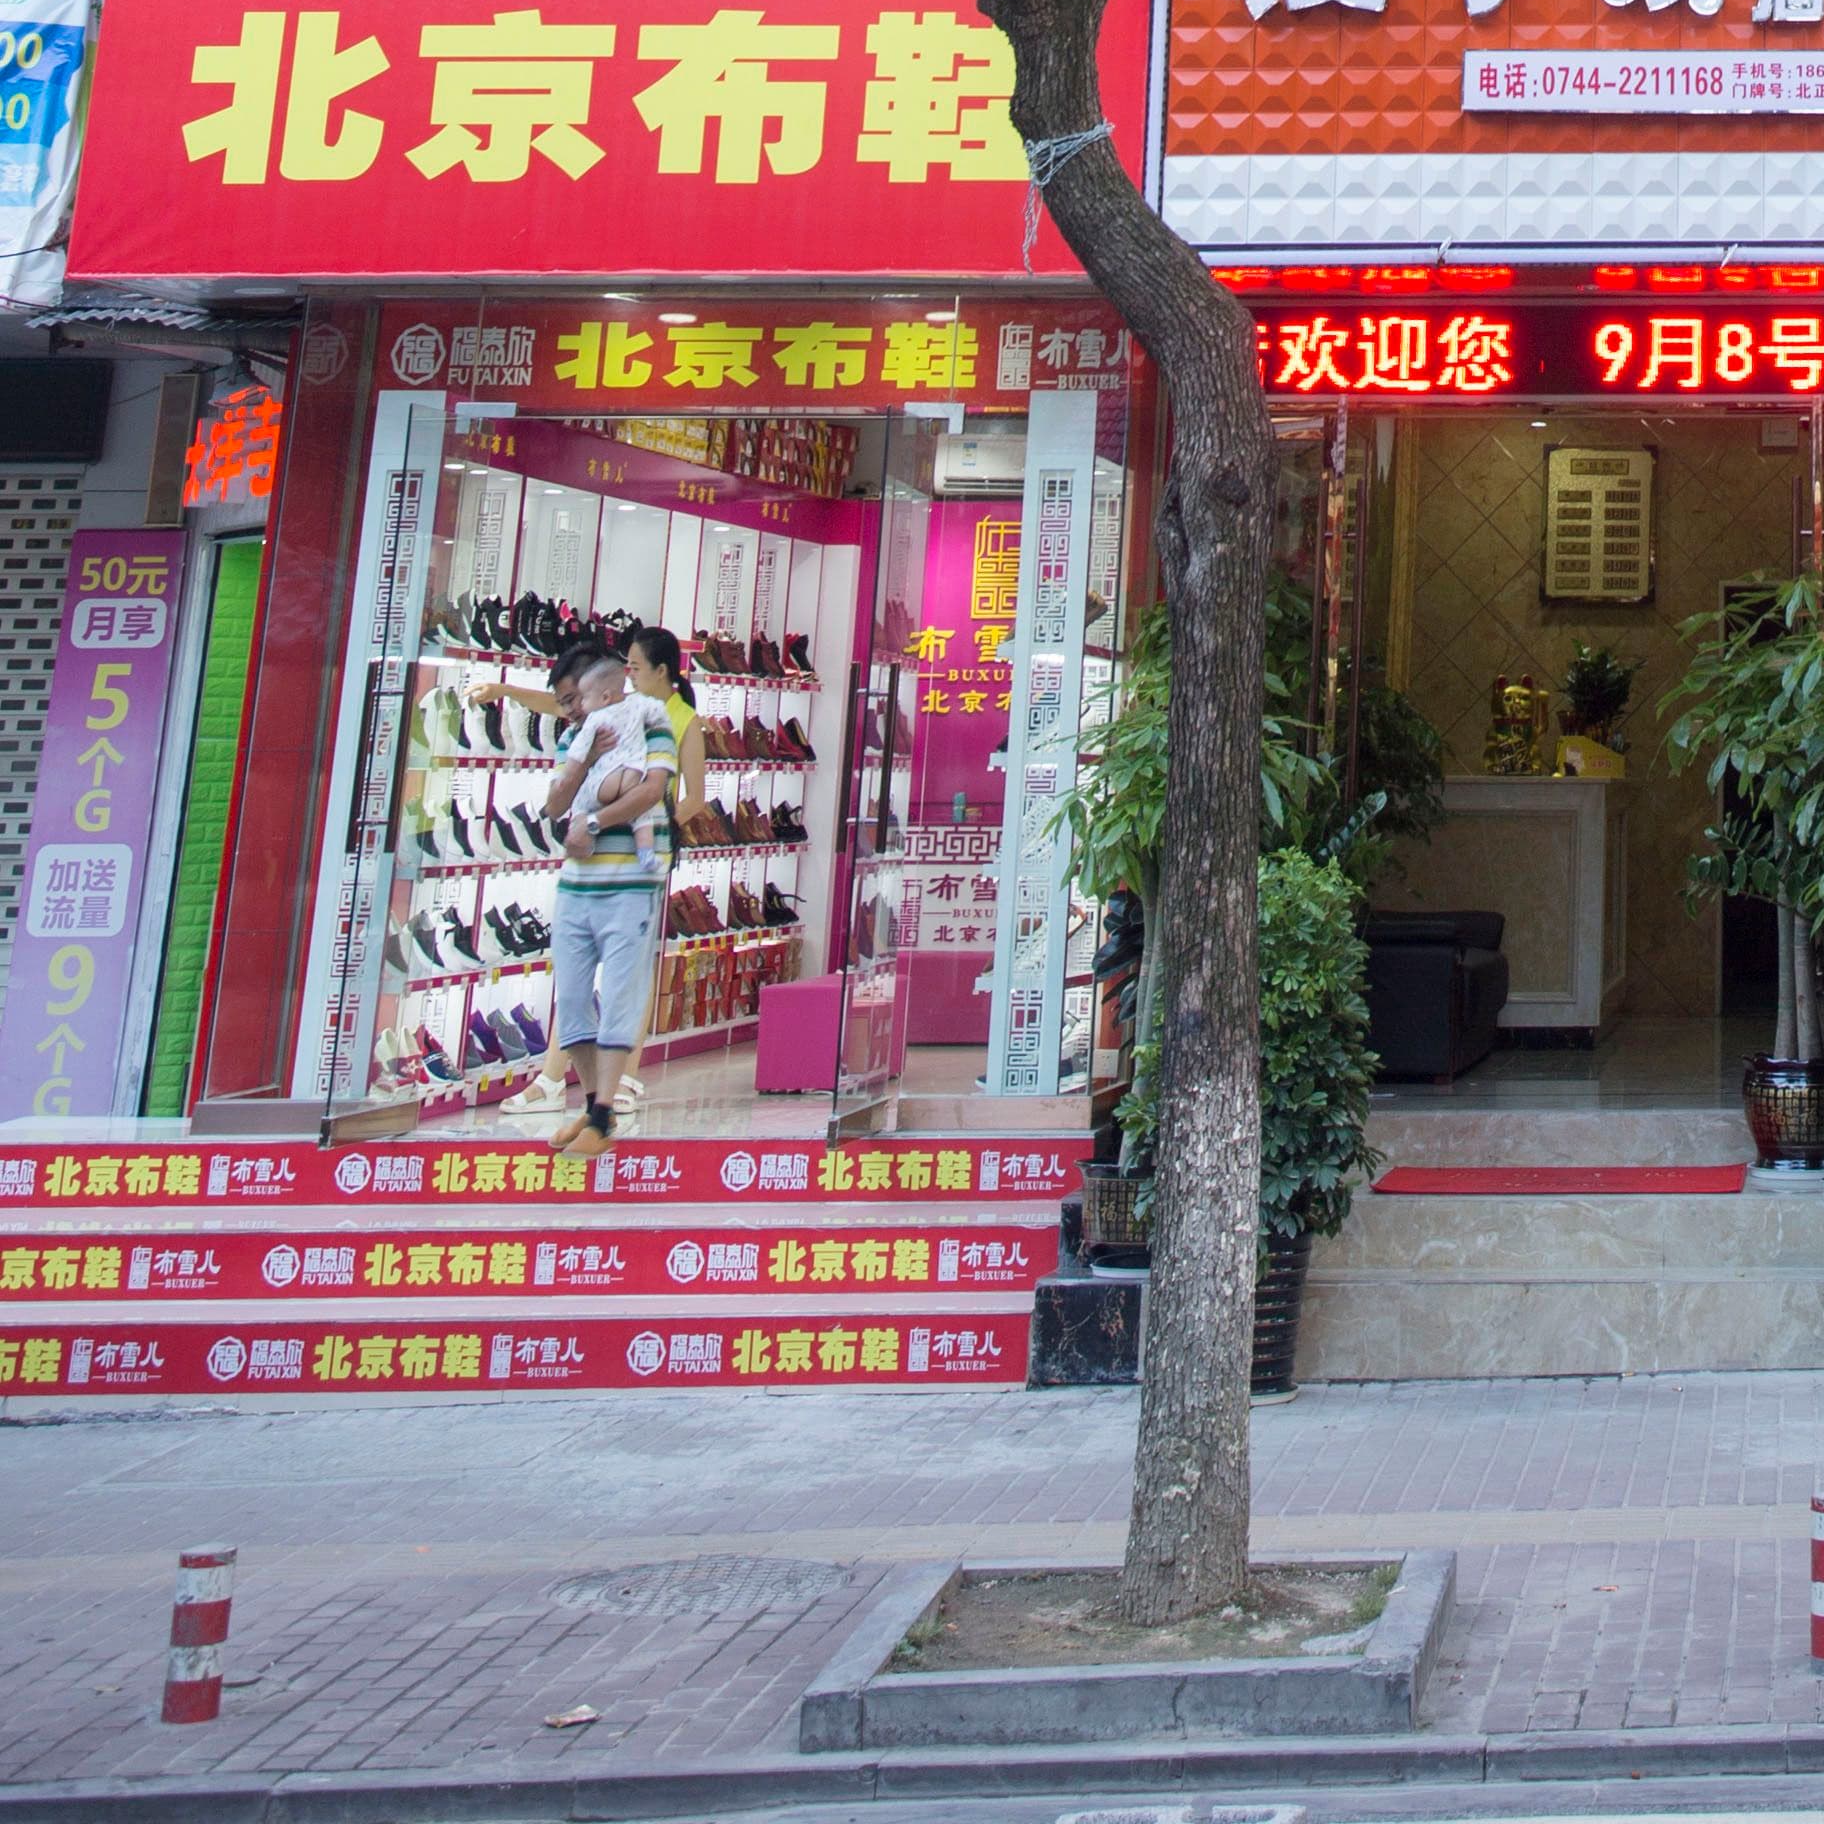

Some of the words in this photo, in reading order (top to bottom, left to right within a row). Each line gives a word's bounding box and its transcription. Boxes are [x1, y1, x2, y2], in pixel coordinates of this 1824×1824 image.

[181, 7, 1032, 186] 北京布鞋
[450, 327, 536, 367] 福泰欣
[554, 320, 979, 390] 北京布鞋
[1257, 315, 1512, 391] 欢迎您
[1057, 374, 1121, 390] BUXUER
[79, 555, 169, 596] 50元
[82, 605, 157, 641] 月享
[946, 668, 1013, 683] BUXU
[46, 857, 117, 893] 加送
[40, 895, 113, 930] 流量
[951, 908, 998, 919] BUXU
[0, 1159, 37, 1184] 泰欣
[44, 1155, 202, 1196] 北京布鞋
[232, 1155, 296, 1183] 布雪儿
[374, 1154, 425, 1180] 福泰欣
[618, 1155, 682, 1181] 布雪儿
[759, 1153, 809, 1178] 福泰欣
[817, 1149, 972, 1192] 北京布鞋
[1001, 1153, 1066, 1180] 布雪儿
[242, 1184, 281, 1195] BUXUER
[628, 1183, 667, 1193] BUXUER
[1013, 1180, 1053, 1192] BUXUER
[0, 1246, 122, 1290] 京布鞋
[153, 1249, 221, 1276] 布雪儿
[303, 1247, 355, 1272] 福泰欣
[364, 1242, 527, 1286] 北京布鞋
[558, 1245, 626, 1272] 布雪儿
[707, 1243, 760, 1269] 福泰欣
[768, 1239, 930, 1283] 北京布鞋
[961, 1241, 1029, 1269] 布雪儿
[164, 1278, 206, 1289] BUXUER
[570, 1274, 611, 1285] BUXUER
[973, 1270, 1014, 1282] BUXUER
[94, 1341, 165, 1369] 布雪儿
[250, 1338, 305, 1365] 福泰欣
[312, 1334, 483, 1381] 北京布鞋
[515, 1336, 585, 1364] 布雪儿
[669, 1333, 723, 1359] 福泰欣
[732, 1328, 901, 1374] 北京布鞋
[933, 1330, 1003, 1358] 布雪儿
[106, 1371, 149, 1383] BUXUER
[527, 1366, 569, 1378] BUXUER
[945, 1359, 988, 1371] BUXUER
